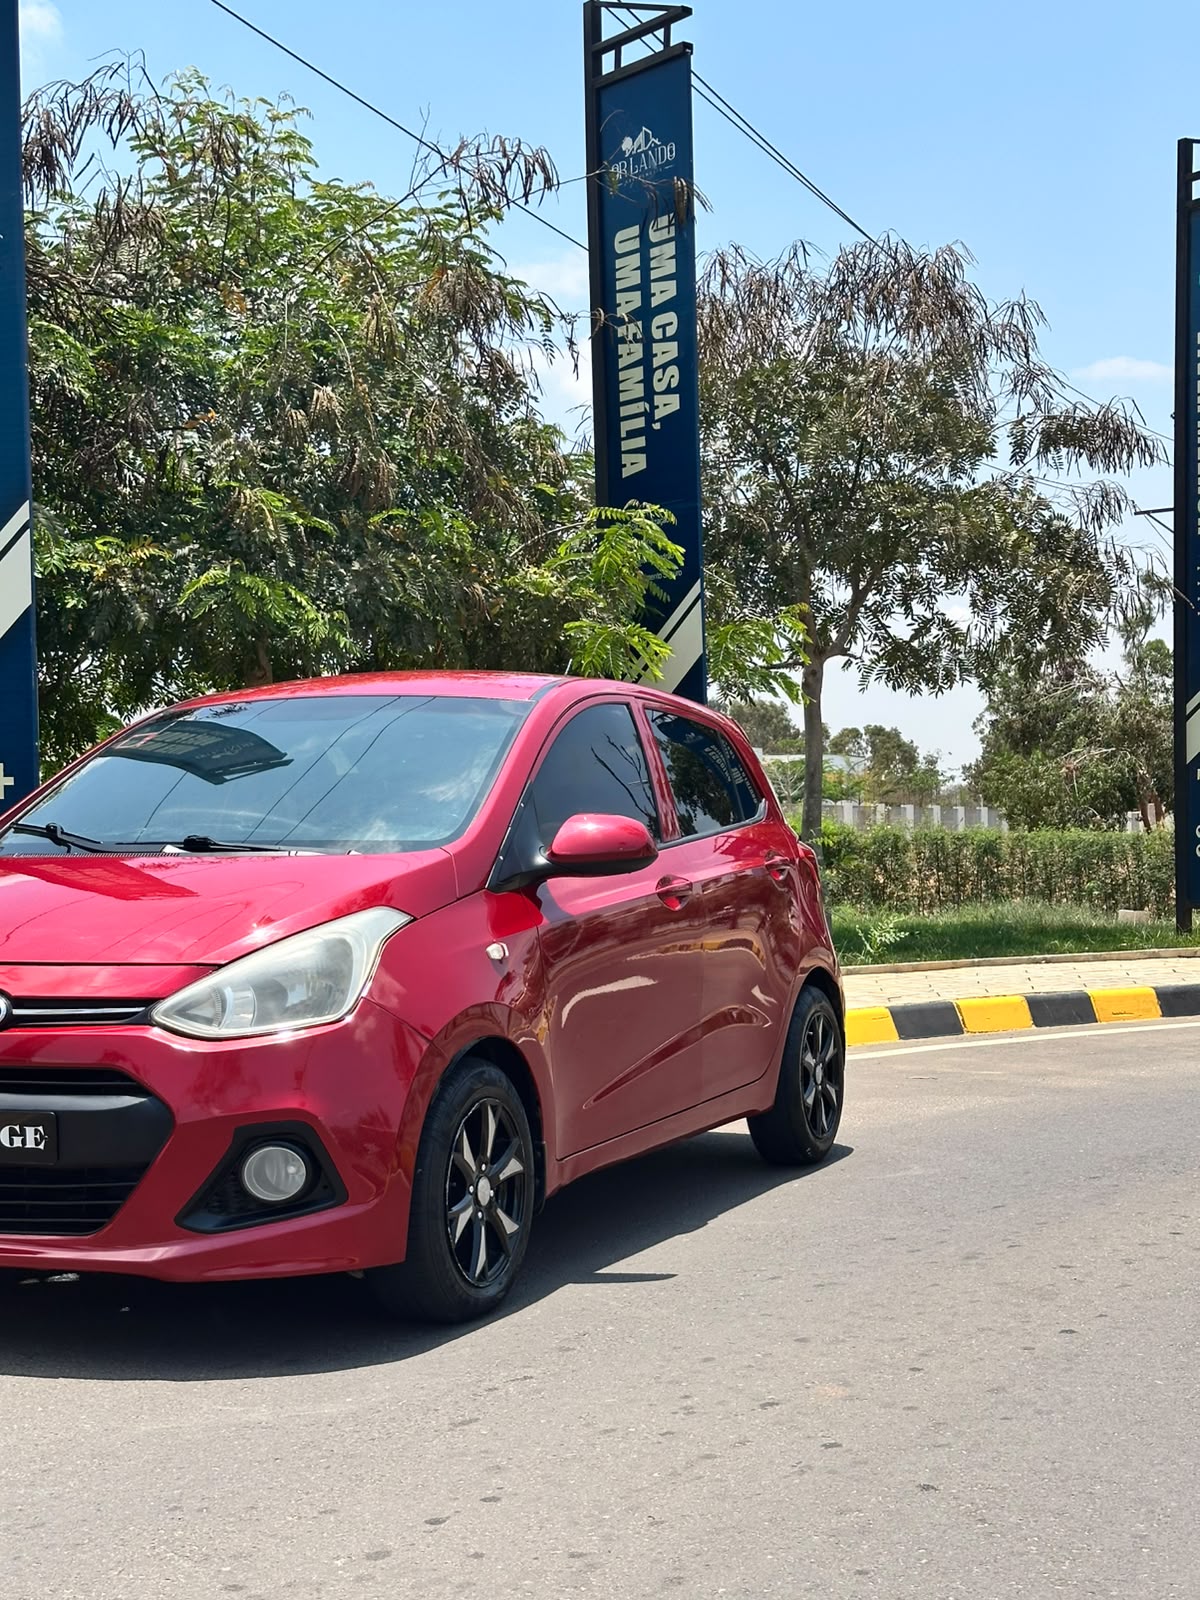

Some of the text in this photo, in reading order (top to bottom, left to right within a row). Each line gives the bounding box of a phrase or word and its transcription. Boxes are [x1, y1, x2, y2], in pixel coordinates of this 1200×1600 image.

[611, 142, 676, 180] ORLANDO
[615, 225, 650, 478] UMA FAMÍLIA
[649, 213, 680, 430] UMA CASA,
